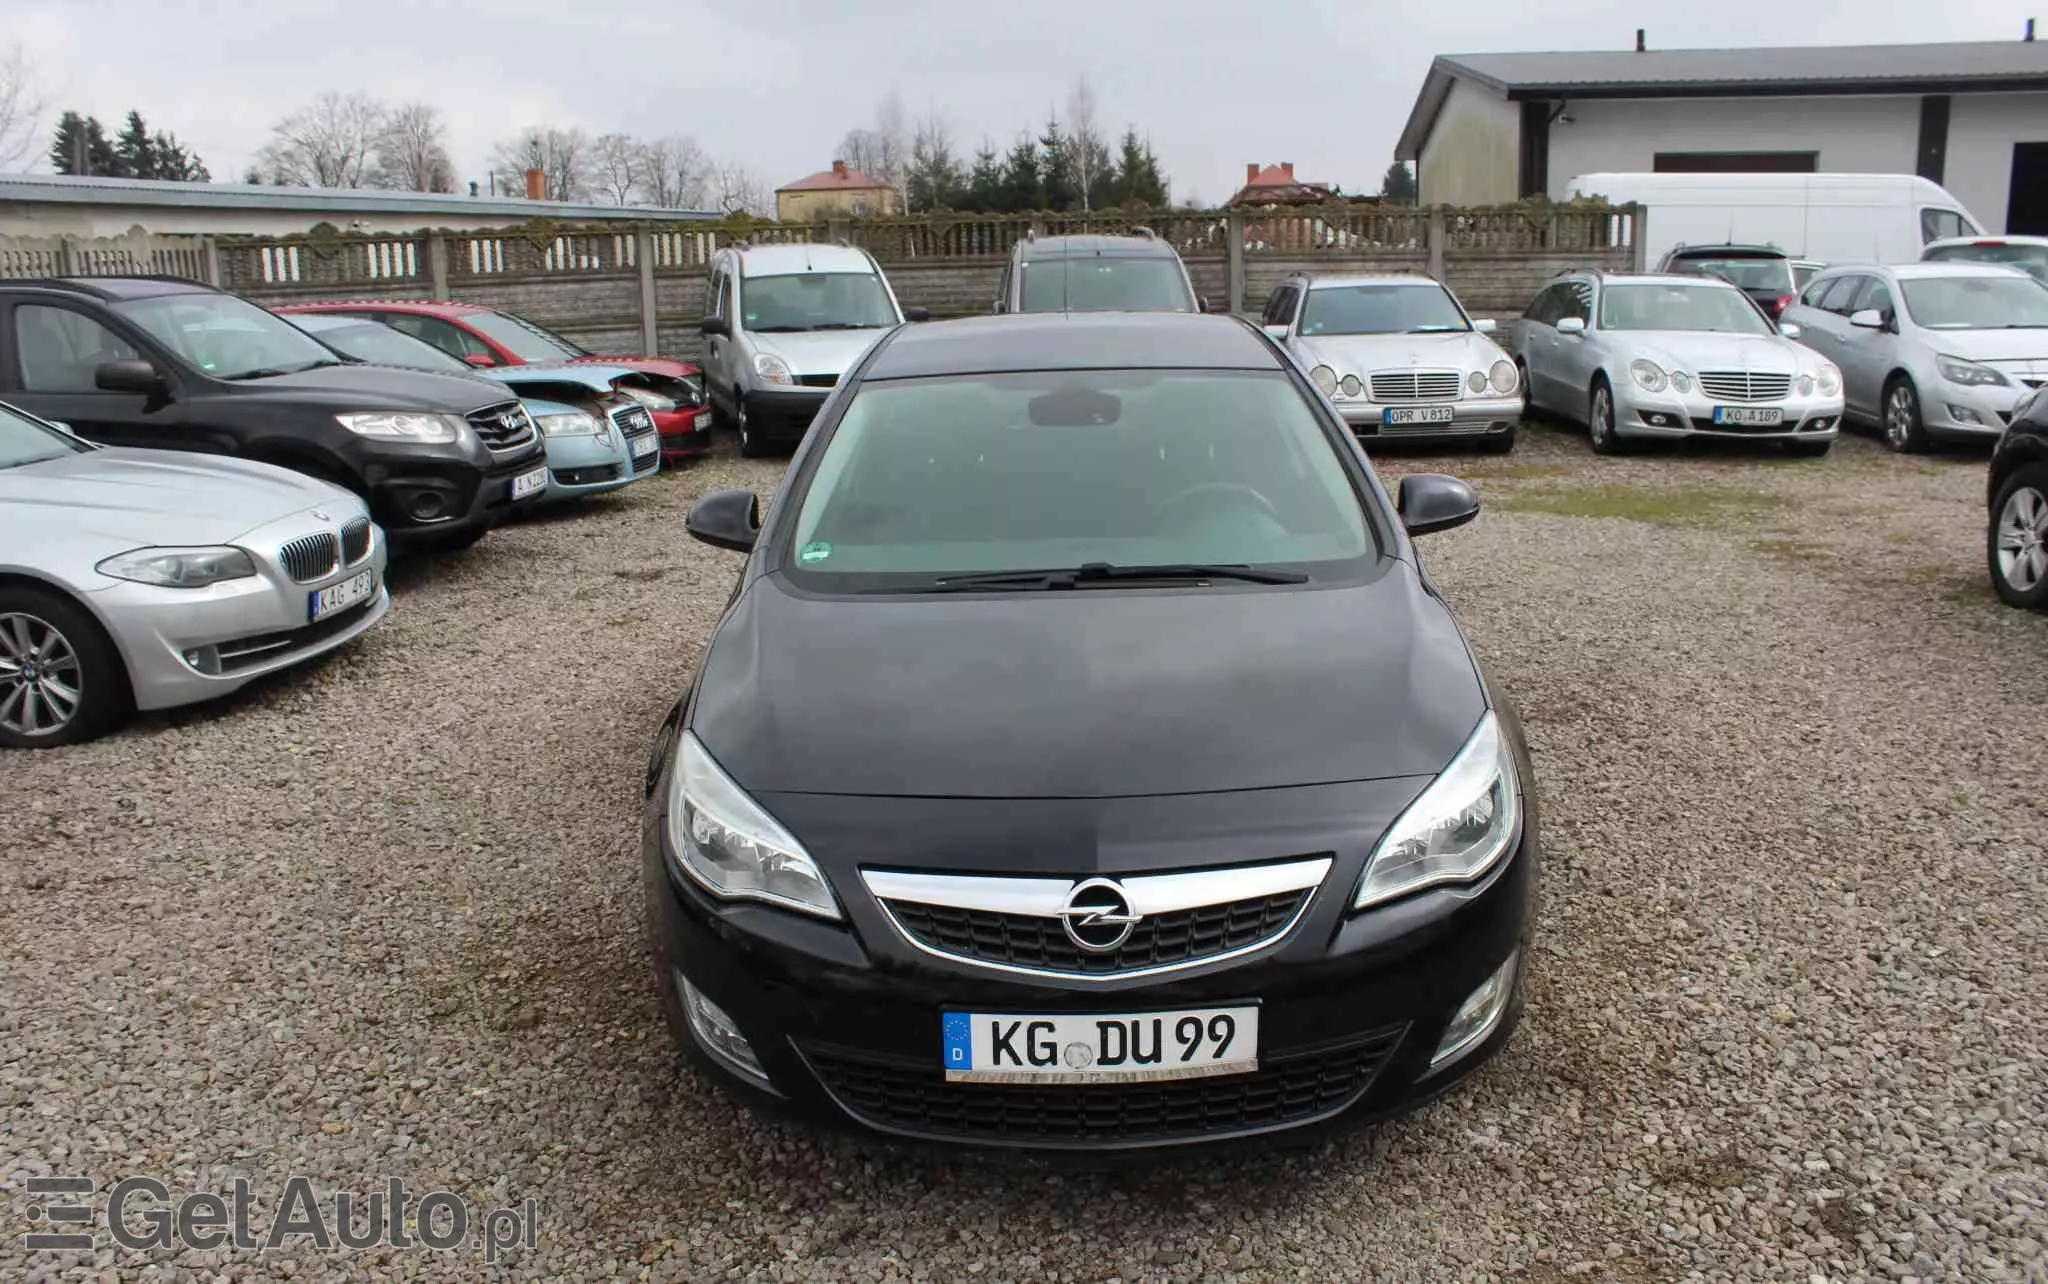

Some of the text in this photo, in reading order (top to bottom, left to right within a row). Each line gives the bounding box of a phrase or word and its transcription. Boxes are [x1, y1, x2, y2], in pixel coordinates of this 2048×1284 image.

[1391, 410, 1414, 422] OPR
[1727, 409, 1742, 421] KO
[320, 584, 345, 611] KAG
[991, 1013, 1237, 1067] KG DU 99
[951, 1047, 963, 1061] D
